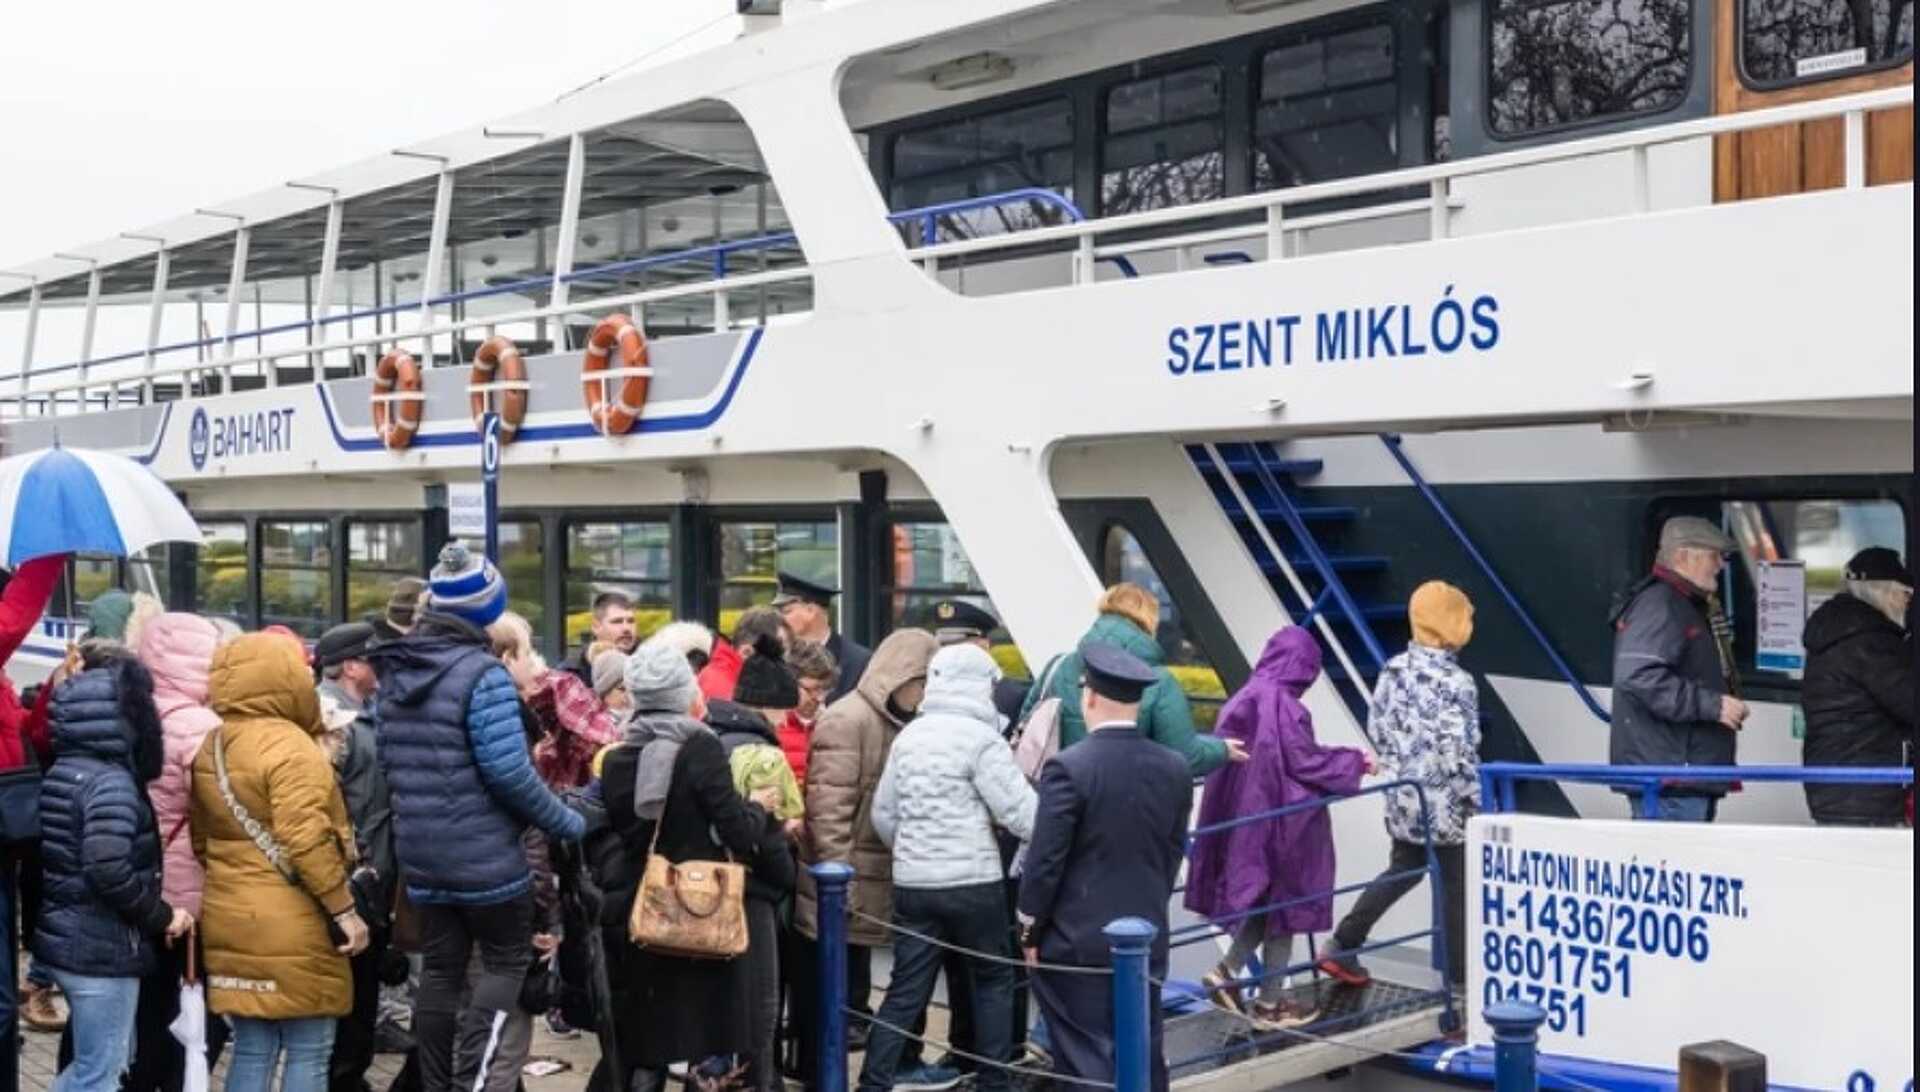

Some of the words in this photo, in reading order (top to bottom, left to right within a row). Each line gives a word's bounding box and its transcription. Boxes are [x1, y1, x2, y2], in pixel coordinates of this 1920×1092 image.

[1167, 314, 1301, 376] SZENT
[1315, 284, 1500, 363] MIKLÓS
[213, 408, 295, 457] BAHART
[484, 415, 498, 471] 6
[1482, 844, 1579, 893] BALATONI
[1585, 855, 1692, 911] HAJÓZÁSI
[1699, 874, 1749, 919] ZRT.
[1481, 883, 1710, 963] H-1436/2006
[1482, 930, 1631, 999] 8601751
